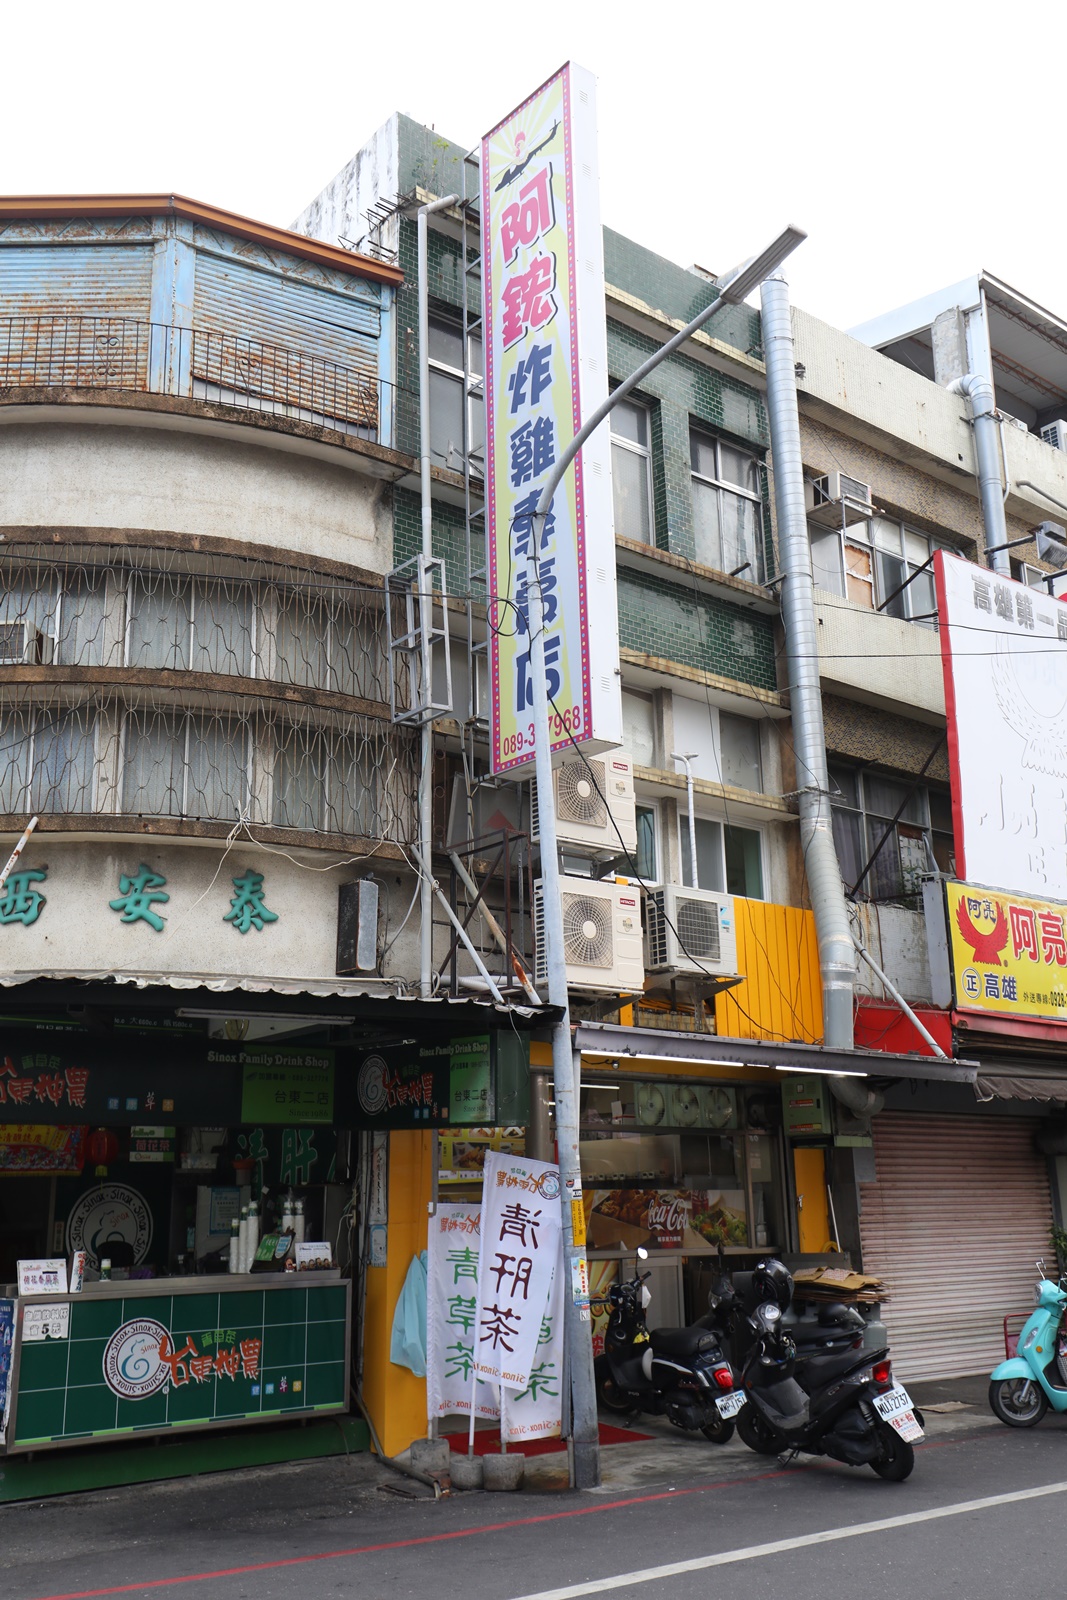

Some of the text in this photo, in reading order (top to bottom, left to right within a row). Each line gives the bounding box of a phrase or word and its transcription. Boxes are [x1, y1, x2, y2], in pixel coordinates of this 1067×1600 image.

[503, 705, 581, 757] 089-37968
[620, 898, 635, 906] HITACHI
[967, 896, 997, 924] 阿亮
[419, 1042, 488, 1057] Sinox Family Drink Shop
[207, 1050, 330, 1069] Sinox Family Drink Shop
[275, 1090, 329, 1105] 台東二店
[454, 1089, 488, 1102] 台東二店
